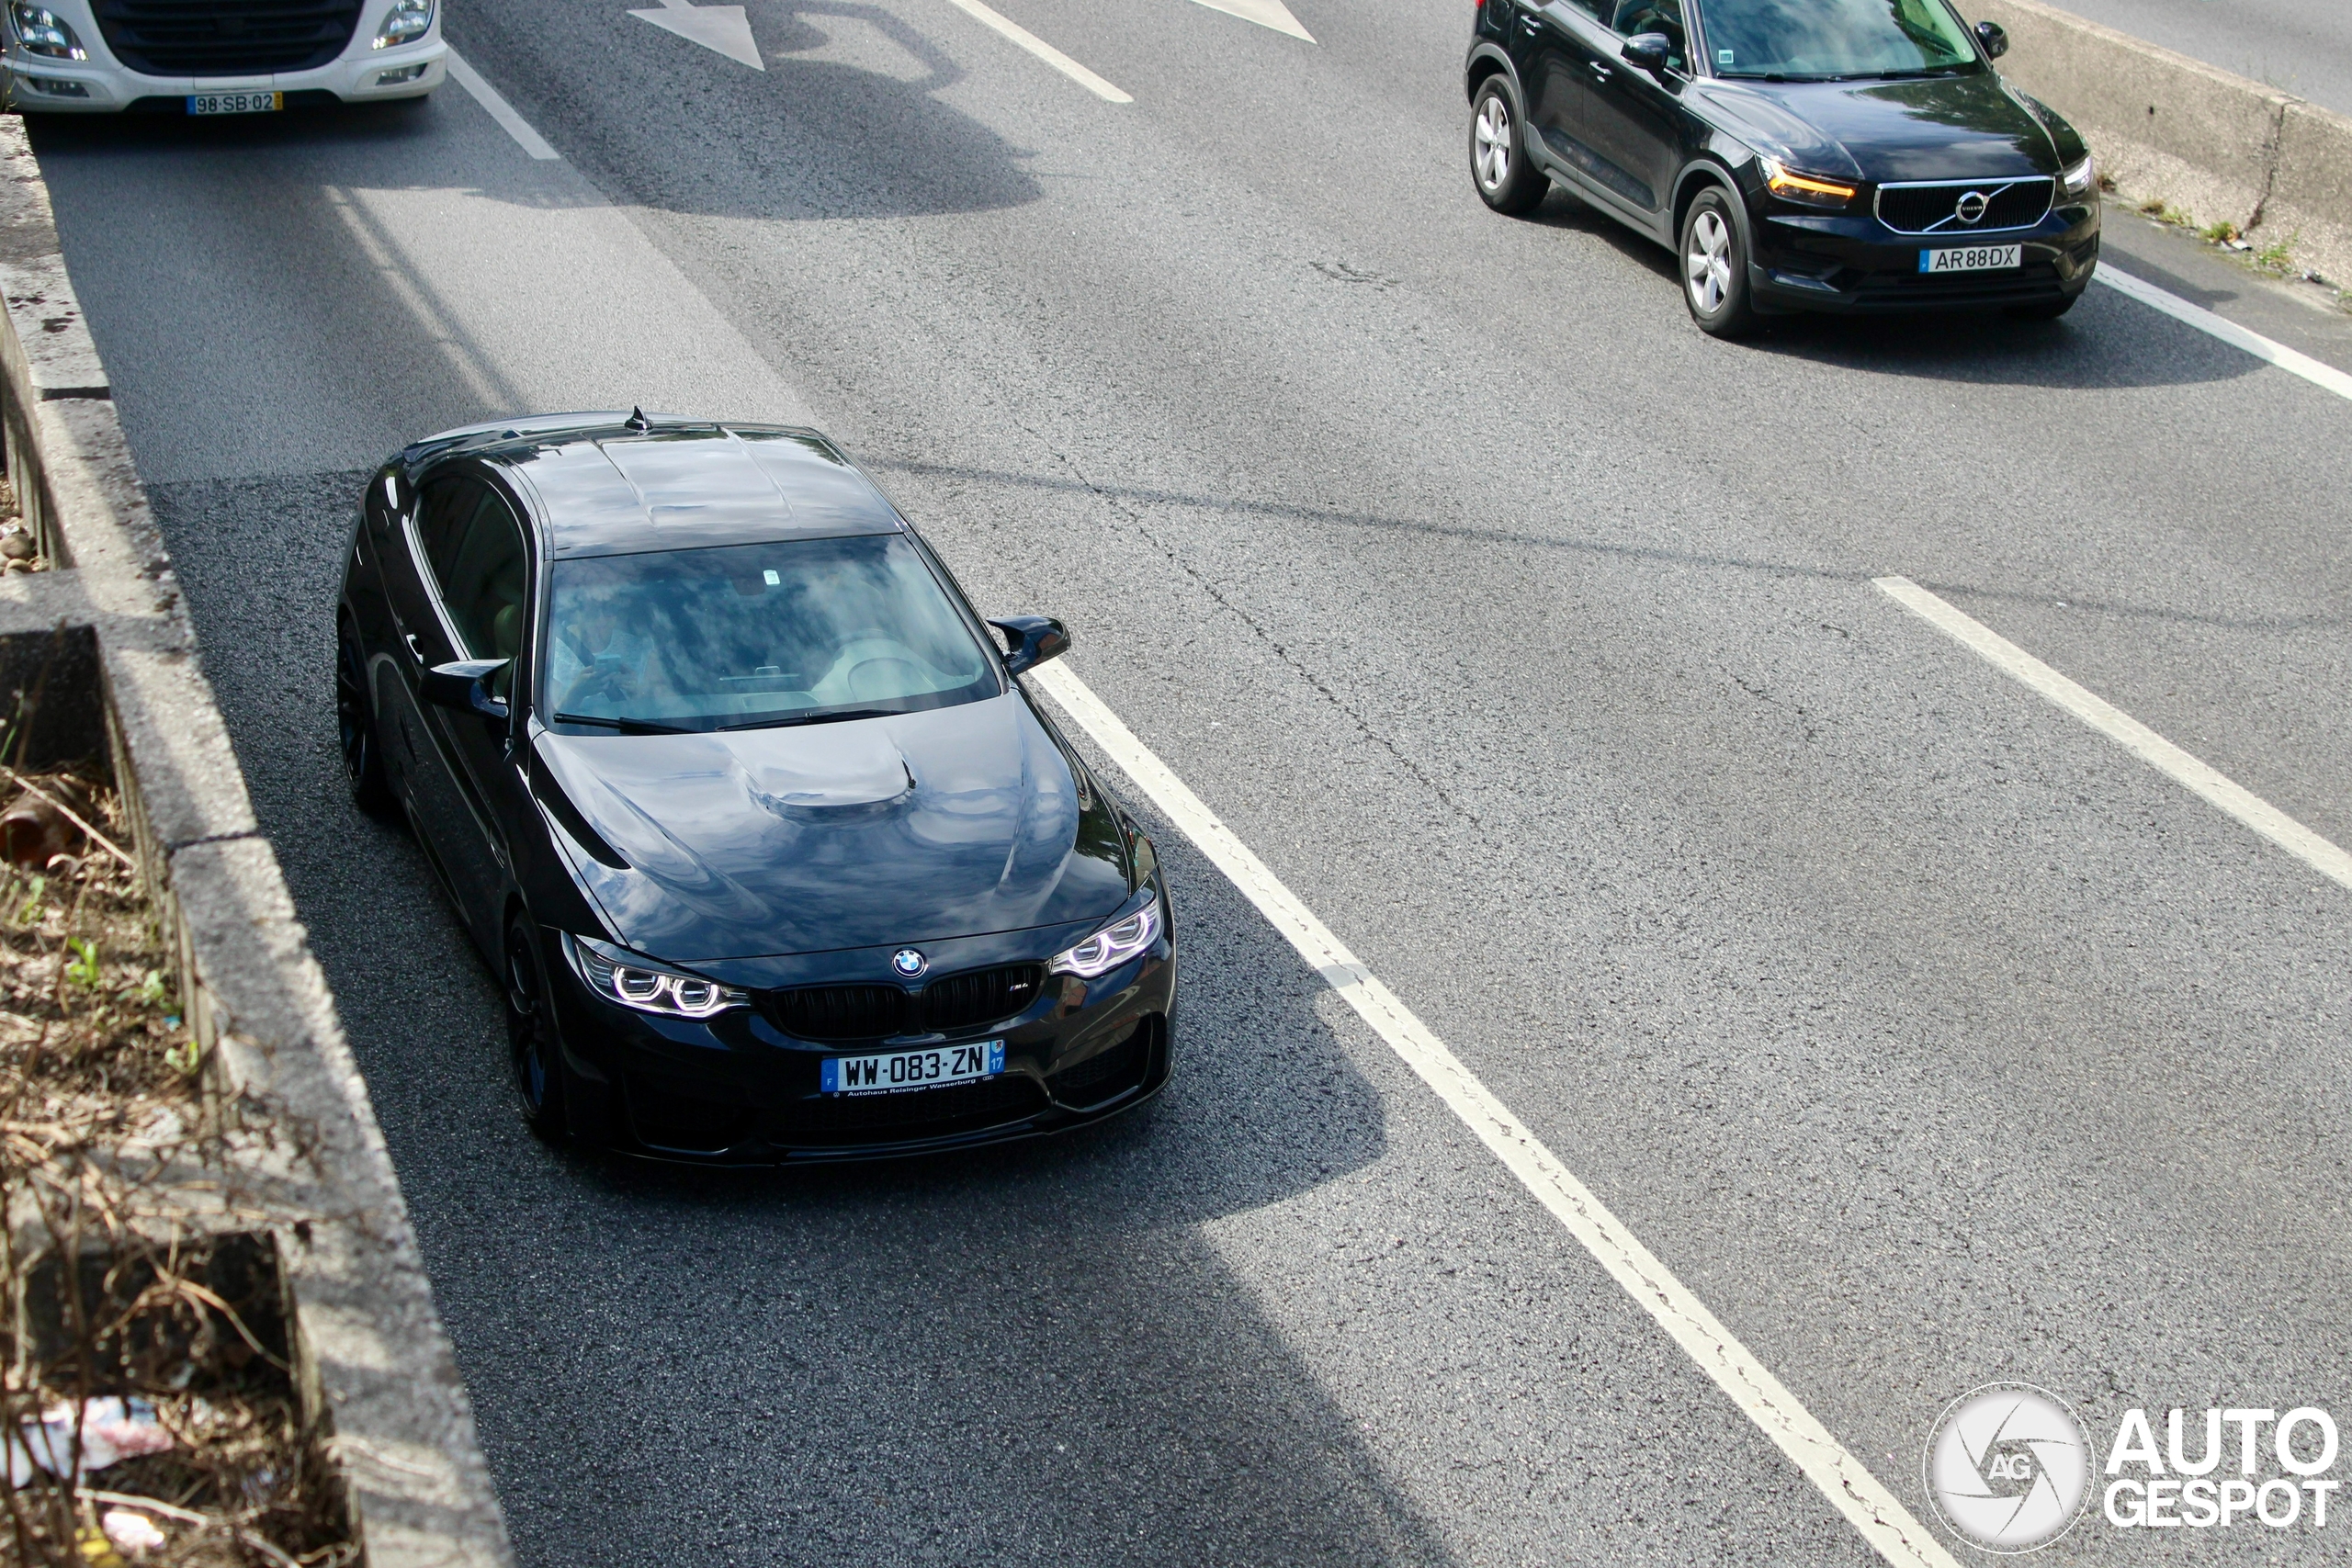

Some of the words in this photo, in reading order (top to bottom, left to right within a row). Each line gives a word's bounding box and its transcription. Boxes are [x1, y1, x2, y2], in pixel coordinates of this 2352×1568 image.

[990, 1056, 1002, 1070] 17
[889, 1085, 927, 1094] Reisinger
[930, 1077, 977, 1089] Wasserburg
